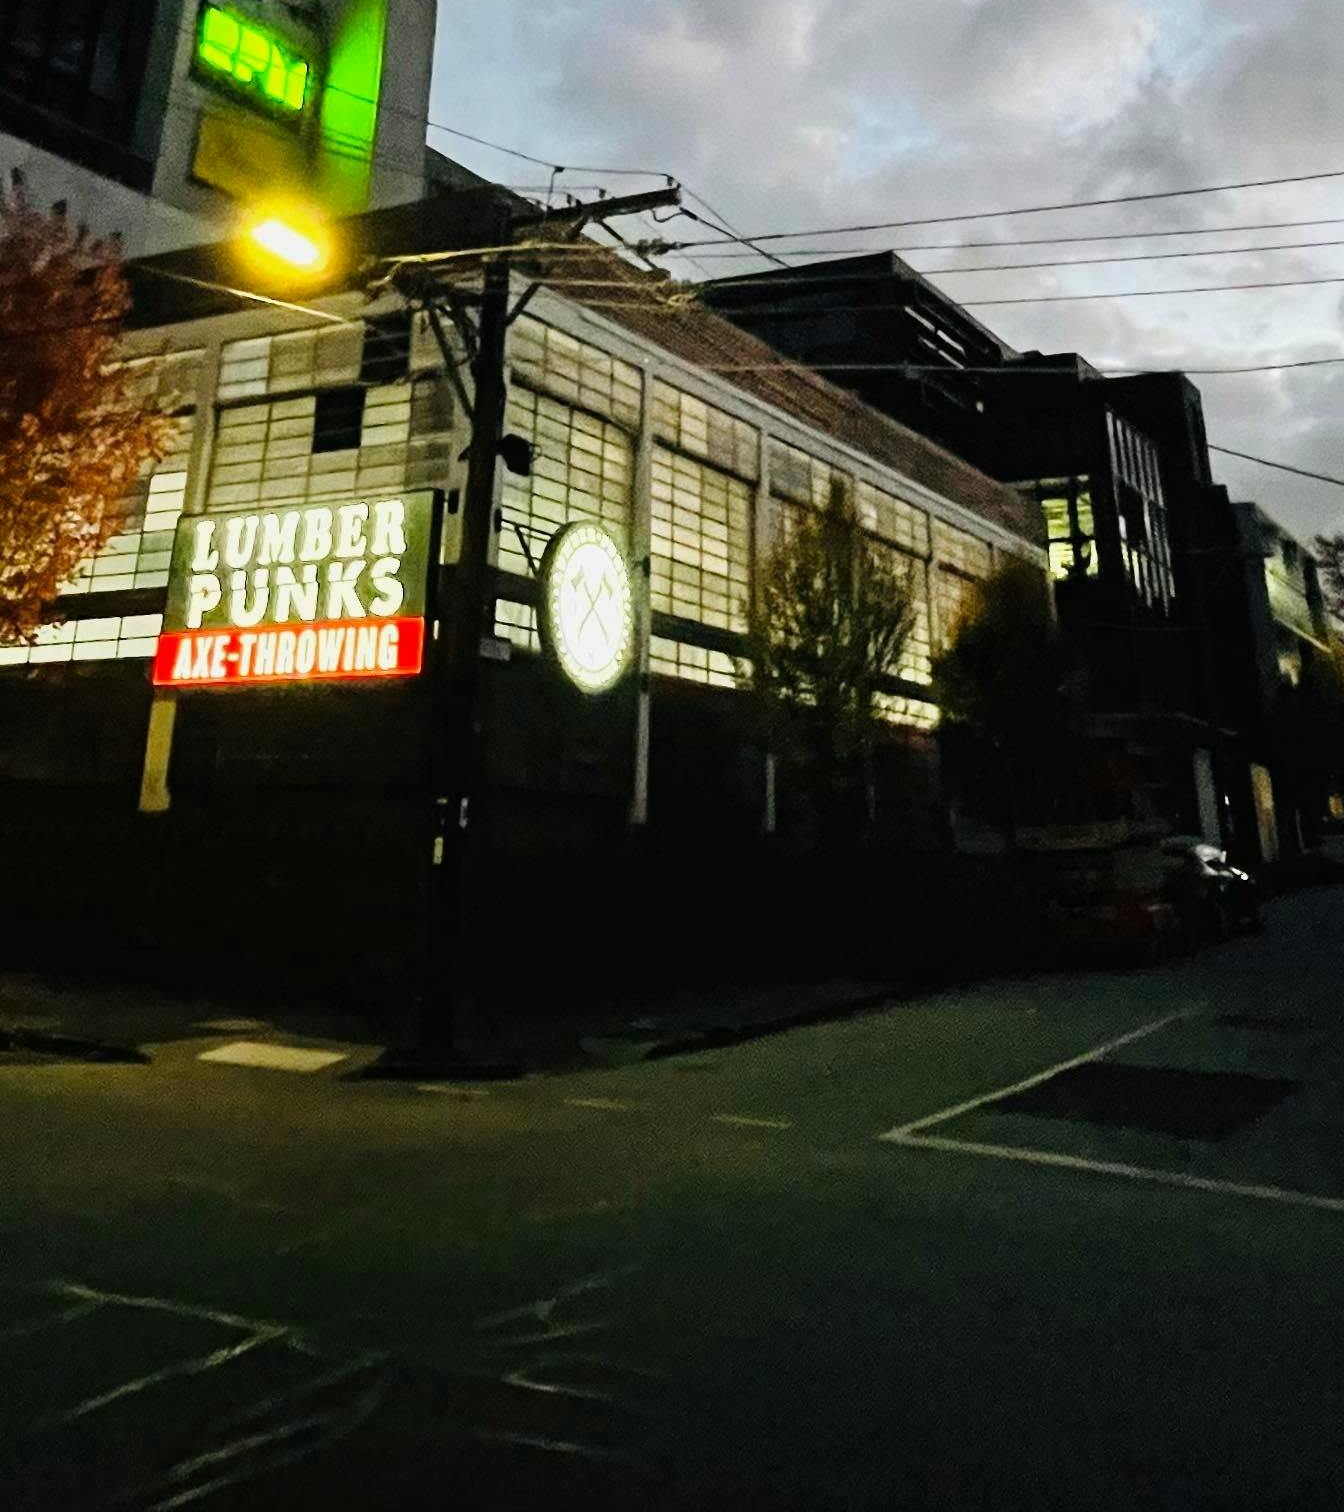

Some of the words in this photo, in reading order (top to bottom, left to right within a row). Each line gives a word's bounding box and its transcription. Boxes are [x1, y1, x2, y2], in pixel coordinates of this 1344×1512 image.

[191, 499, 408, 572] LUMBER
[187, 556, 405, 629] PUNKS
[172, 624, 400, 680] AXE-THROWING
